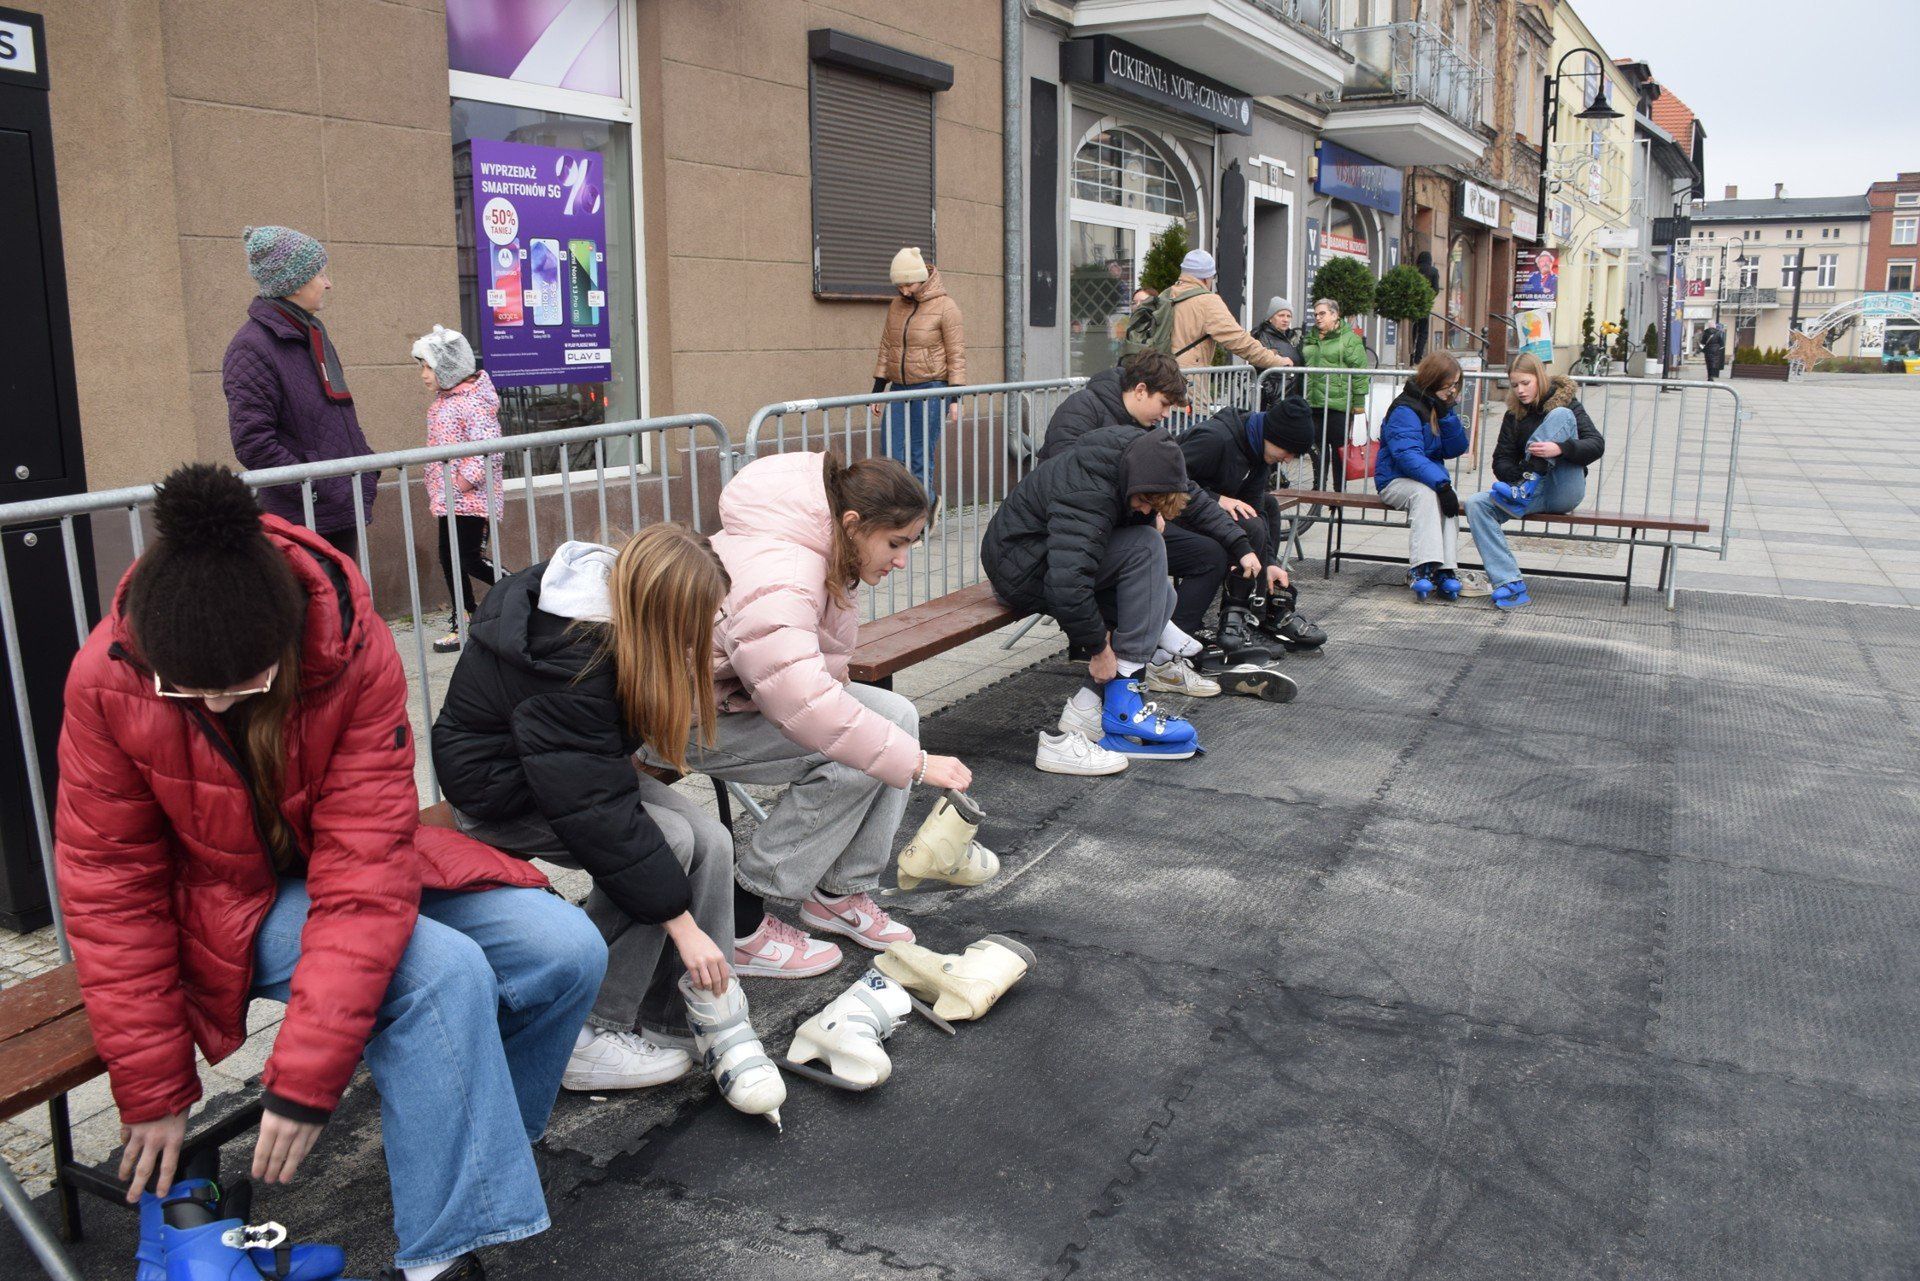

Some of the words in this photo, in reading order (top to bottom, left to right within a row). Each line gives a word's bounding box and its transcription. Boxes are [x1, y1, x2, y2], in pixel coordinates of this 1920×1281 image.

[1109, 50, 1168, 94] CUKIERNIA
[480, 162, 537, 179] WYPRZEDAŻ
[481, 180, 546, 197] SMARTFONÓW
[547, 185, 561, 198] 5G
[491, 208, 516, 225] 50%
[491, 226, 512, 235] TANIEJ
[567, 353, 595, 361] PLAY
